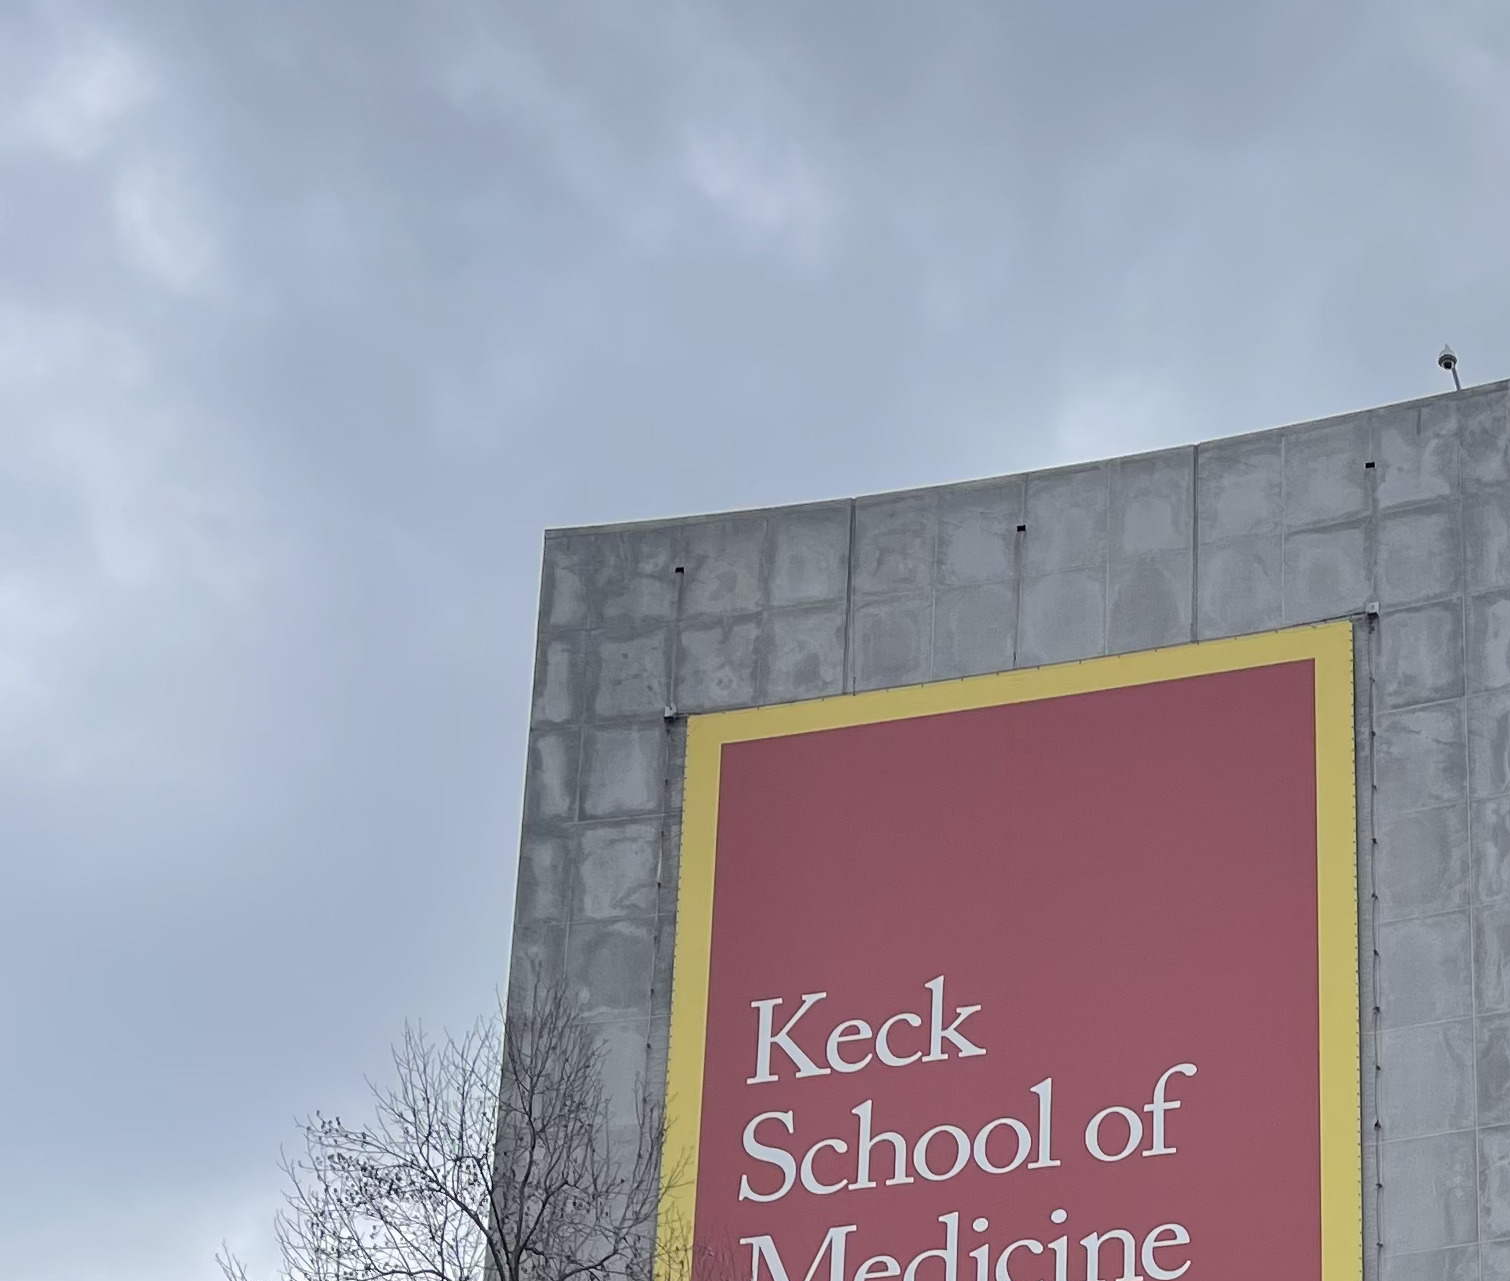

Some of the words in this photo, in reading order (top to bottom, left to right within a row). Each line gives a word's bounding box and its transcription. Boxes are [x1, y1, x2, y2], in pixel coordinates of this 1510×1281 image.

[746, 974, 986, 1085] Keck
[738, 1077, 1060, 1202] School
[1085, 1063, 1197, 1162] of
